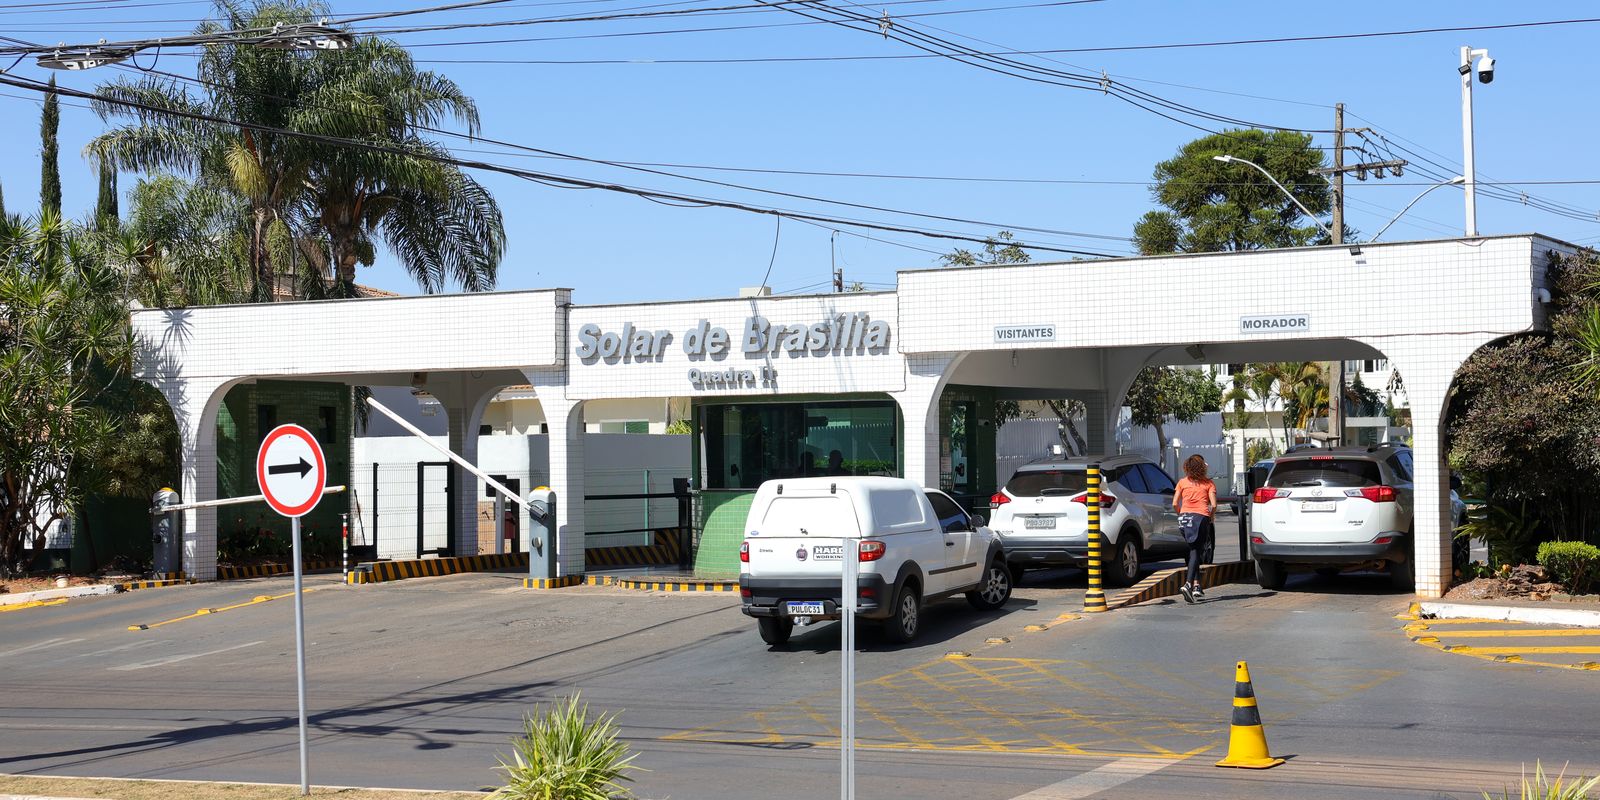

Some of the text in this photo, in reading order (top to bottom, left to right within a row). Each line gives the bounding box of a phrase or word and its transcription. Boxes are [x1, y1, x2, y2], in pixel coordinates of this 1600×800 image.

[1242, 317, 1307, 330] MORADOR
[575, 311, 890, 359] Solar de Brasília
[996, 327, 1054, 340] VISITANTES
[688, 366, 753, 383] Quadra
